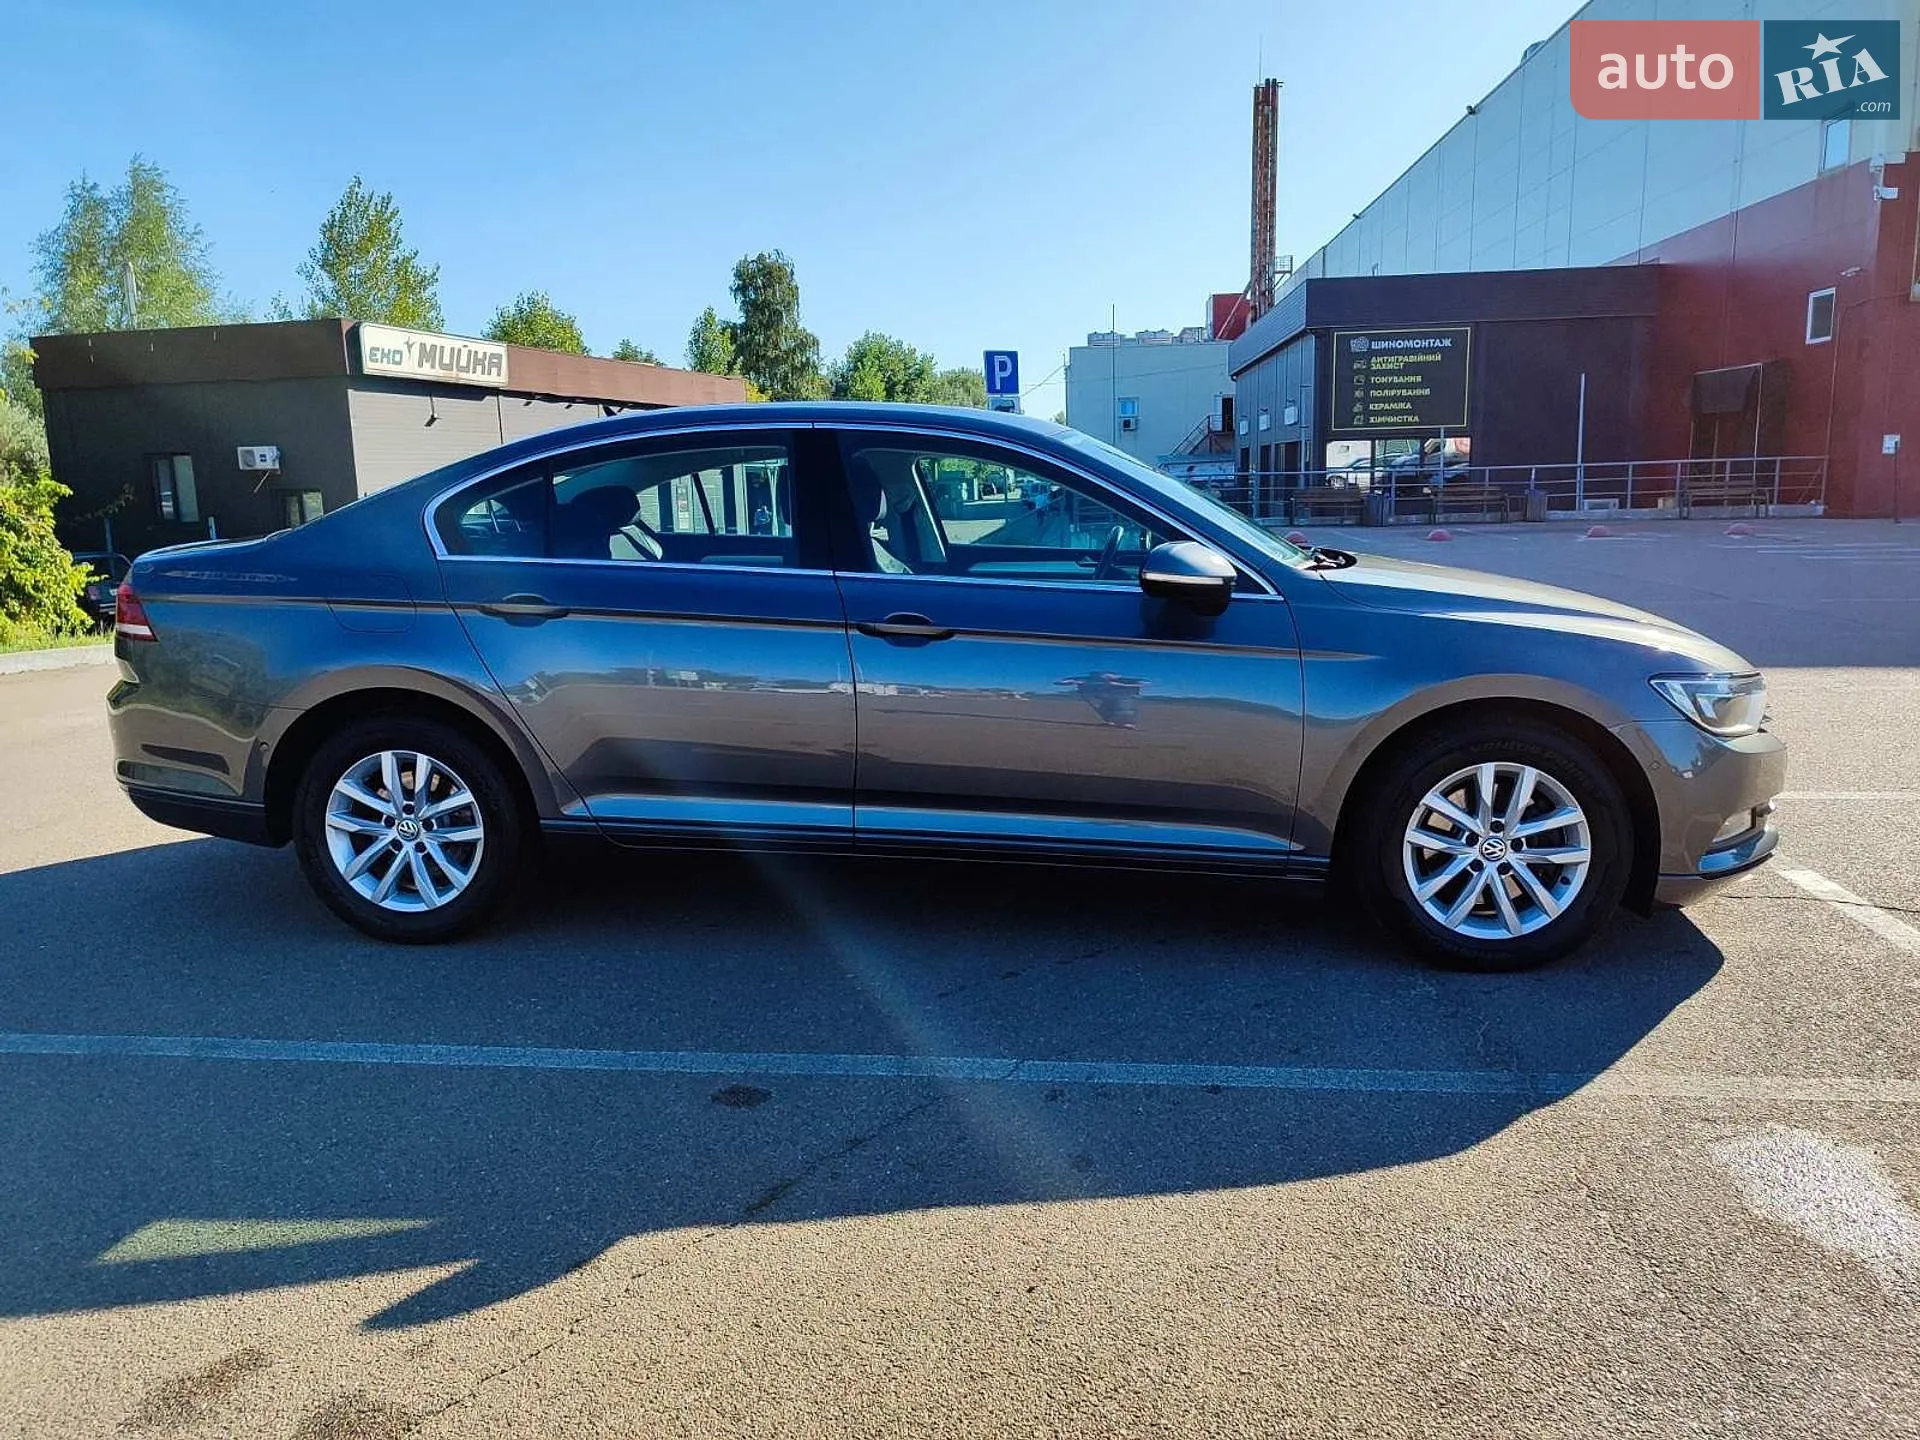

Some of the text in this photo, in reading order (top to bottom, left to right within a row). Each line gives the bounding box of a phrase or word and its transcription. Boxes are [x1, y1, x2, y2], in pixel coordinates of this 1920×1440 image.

[1371, 338, 1452, 349] ШИНОМОНТАЖ
[418, 342, 503, 377] МИЙКА
[994, 355, 1012, 390] P
[1370, 388, 1430, 398] ПОЛІРУВАННЯ
[1369, 402, 1412, 411] КЕРАМІКА
